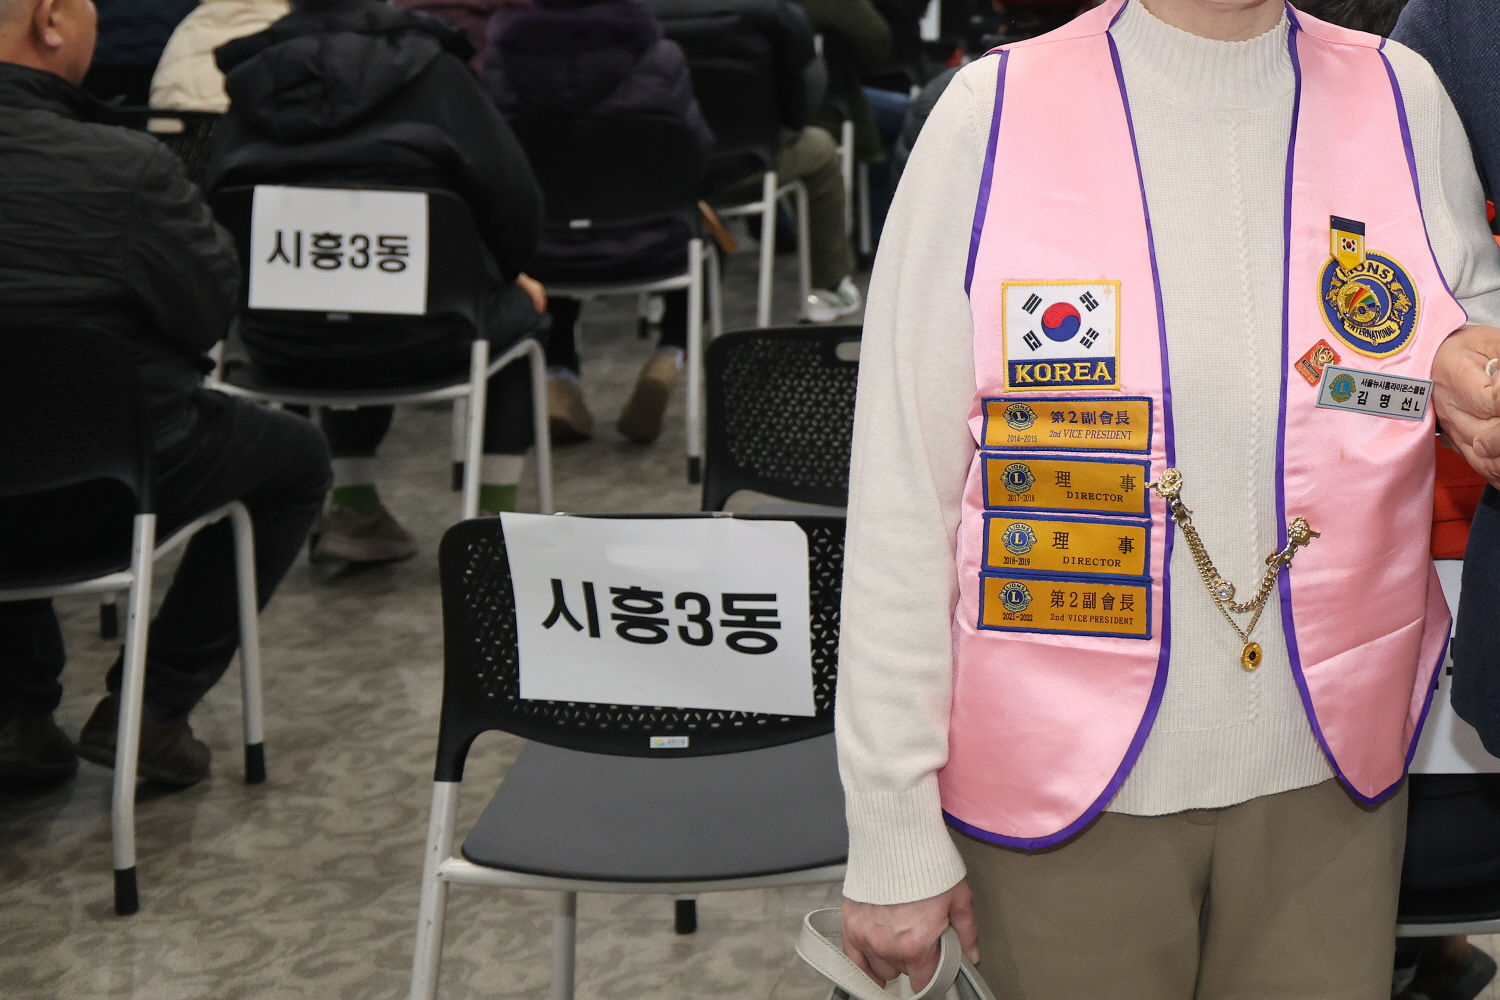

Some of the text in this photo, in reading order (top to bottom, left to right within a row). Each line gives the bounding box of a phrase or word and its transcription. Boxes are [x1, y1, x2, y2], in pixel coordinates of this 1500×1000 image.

[267, 230, 410, 273] 시흥3동
[1015, 362, 1112, 383] KOREA
[1357, 391, 1369, 406] 김
[1380, 394, 1391, 408] 명
[1401, 397, 1413, 411] 선
[1050, 410, 1130, 425] 第2副會長
[1006, 435, 1038, 443] 2014-2015
[1049, 429, 1133, 440] 2nd VICE PRESIDENT
[1055, 471, 1136, 492] 理 事
[1066, 491, 1124, 502] DIRECTOR
[1052, 531, 1135, 554] 理 事
[1003, 556, 1031, 565] 2018-2019
[1063, 556, 1122, 567] DIRECTOR
[1050, 589, 1135, 611] 第2副會長
[541, 578, 781, 655] 시흥3동
[1002, 612, 1033, 621] 2021-2022
[1050, 613, 1134, 625] 2nd VICE PRESIDENT
